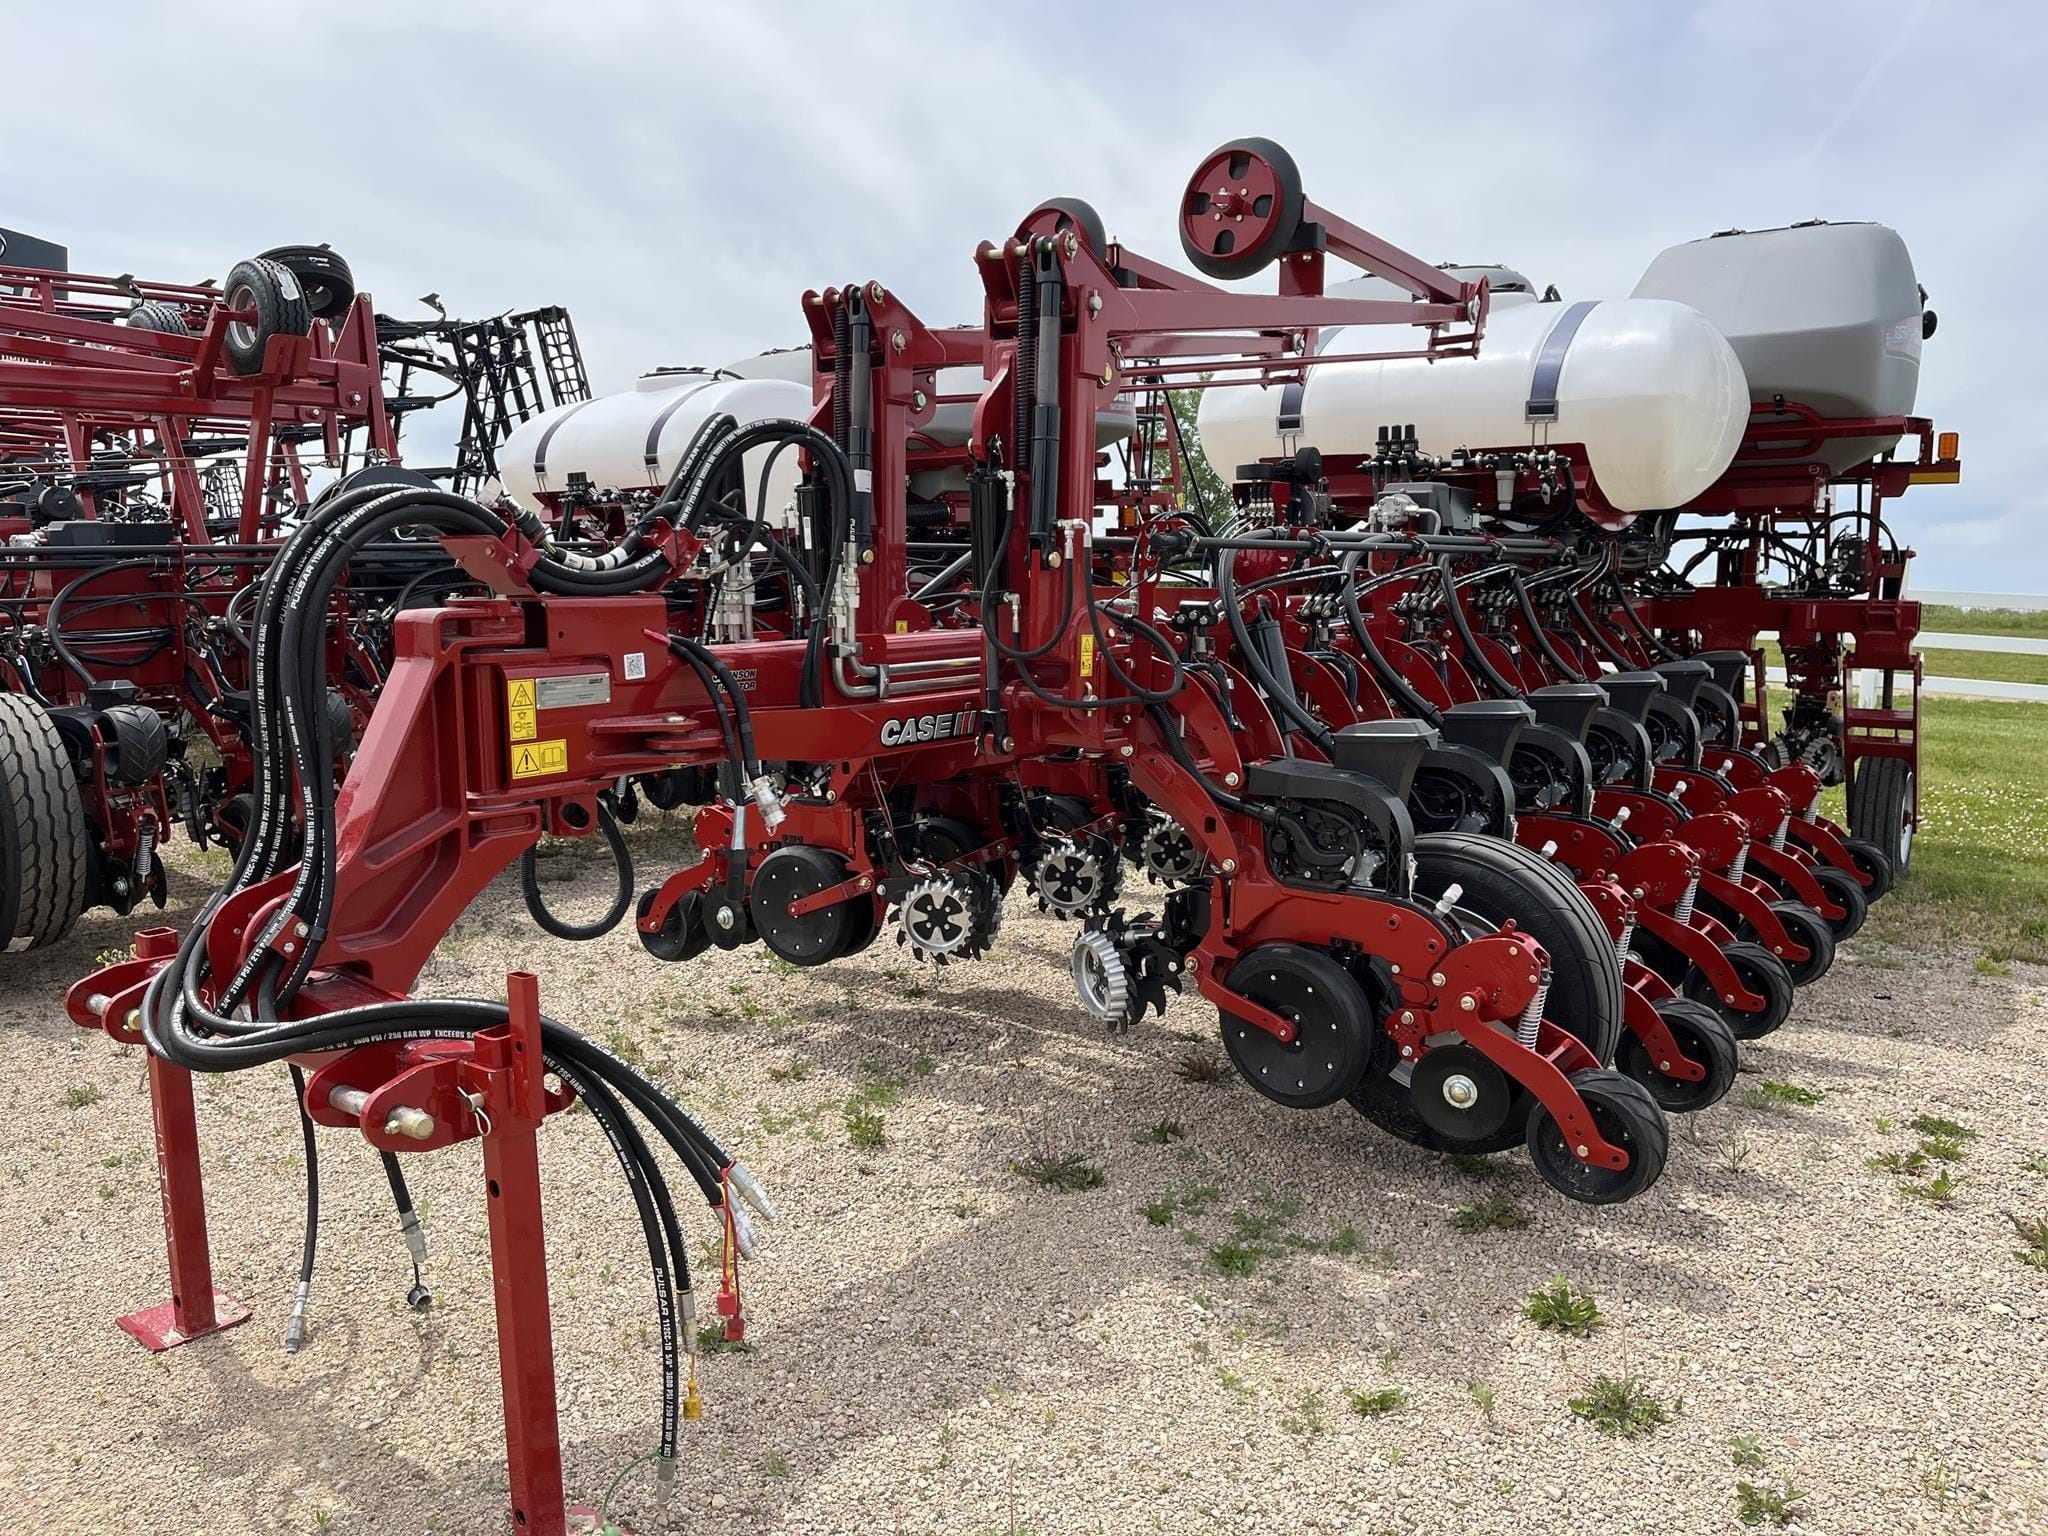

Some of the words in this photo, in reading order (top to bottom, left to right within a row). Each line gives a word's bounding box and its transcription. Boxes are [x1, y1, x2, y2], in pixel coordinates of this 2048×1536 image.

[279, 576, 298, 624] PULSAR
[290, 565, 314, 609] PULSAR
[880, 713, 954, 747] CASE
[230, 977, 245, 995] 3100
[242, 965, 252, 978] PSI
[293, 885, 304, 898] SAE
[305, 845, 314, 858] SAE
[434, 1029, 464, 1038] EXCEEDS
[557, 1067, 571, 1080] 2SC
[569, 1078, 586, 1095] HARC
[655, 1267, 669, 1316] PULSAR
[662, 1319, 673, 1351] 112CC-10
[665, 1405, 674, 1417] 250
[666, 1389, 674, 1400] PSI
